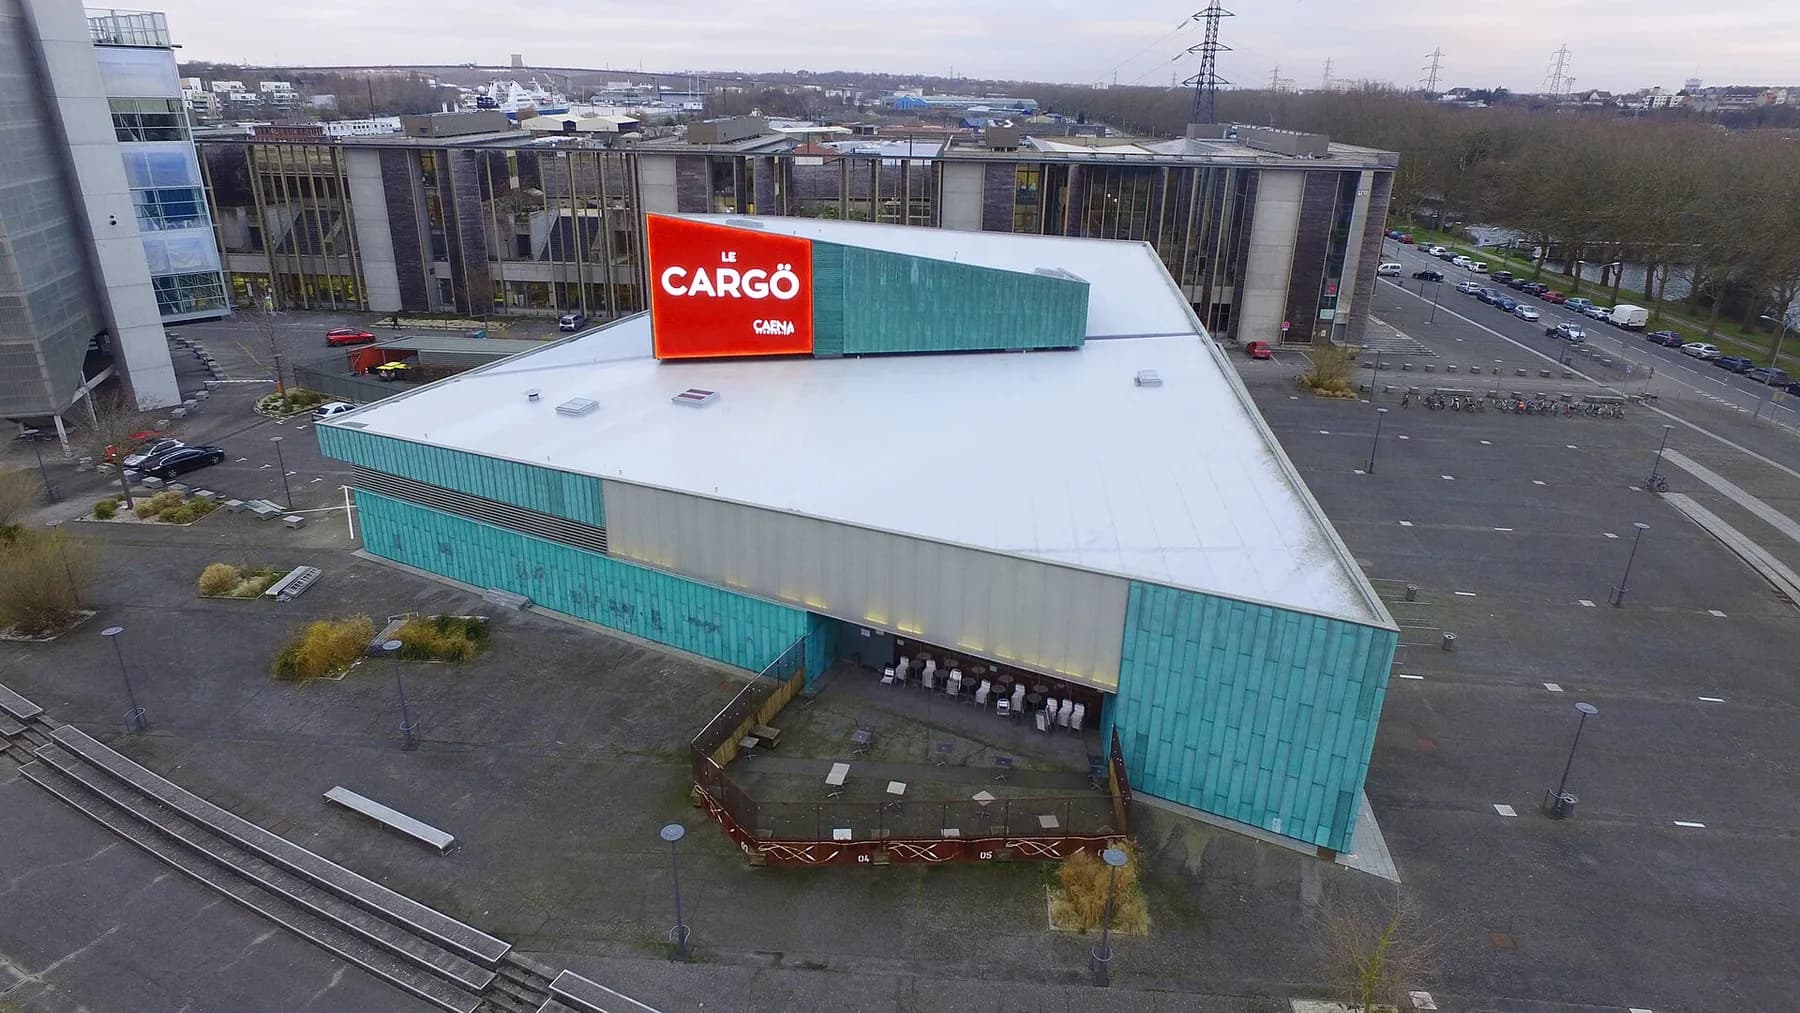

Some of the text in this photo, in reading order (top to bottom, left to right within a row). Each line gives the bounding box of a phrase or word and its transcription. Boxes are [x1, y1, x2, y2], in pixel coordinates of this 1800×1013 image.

[721, 252, 736, 262] LE
[661, 263, 800, 300] CARGÖ
[858, 855, 869, 863] 04
[980, 851, 992, 859] 05
